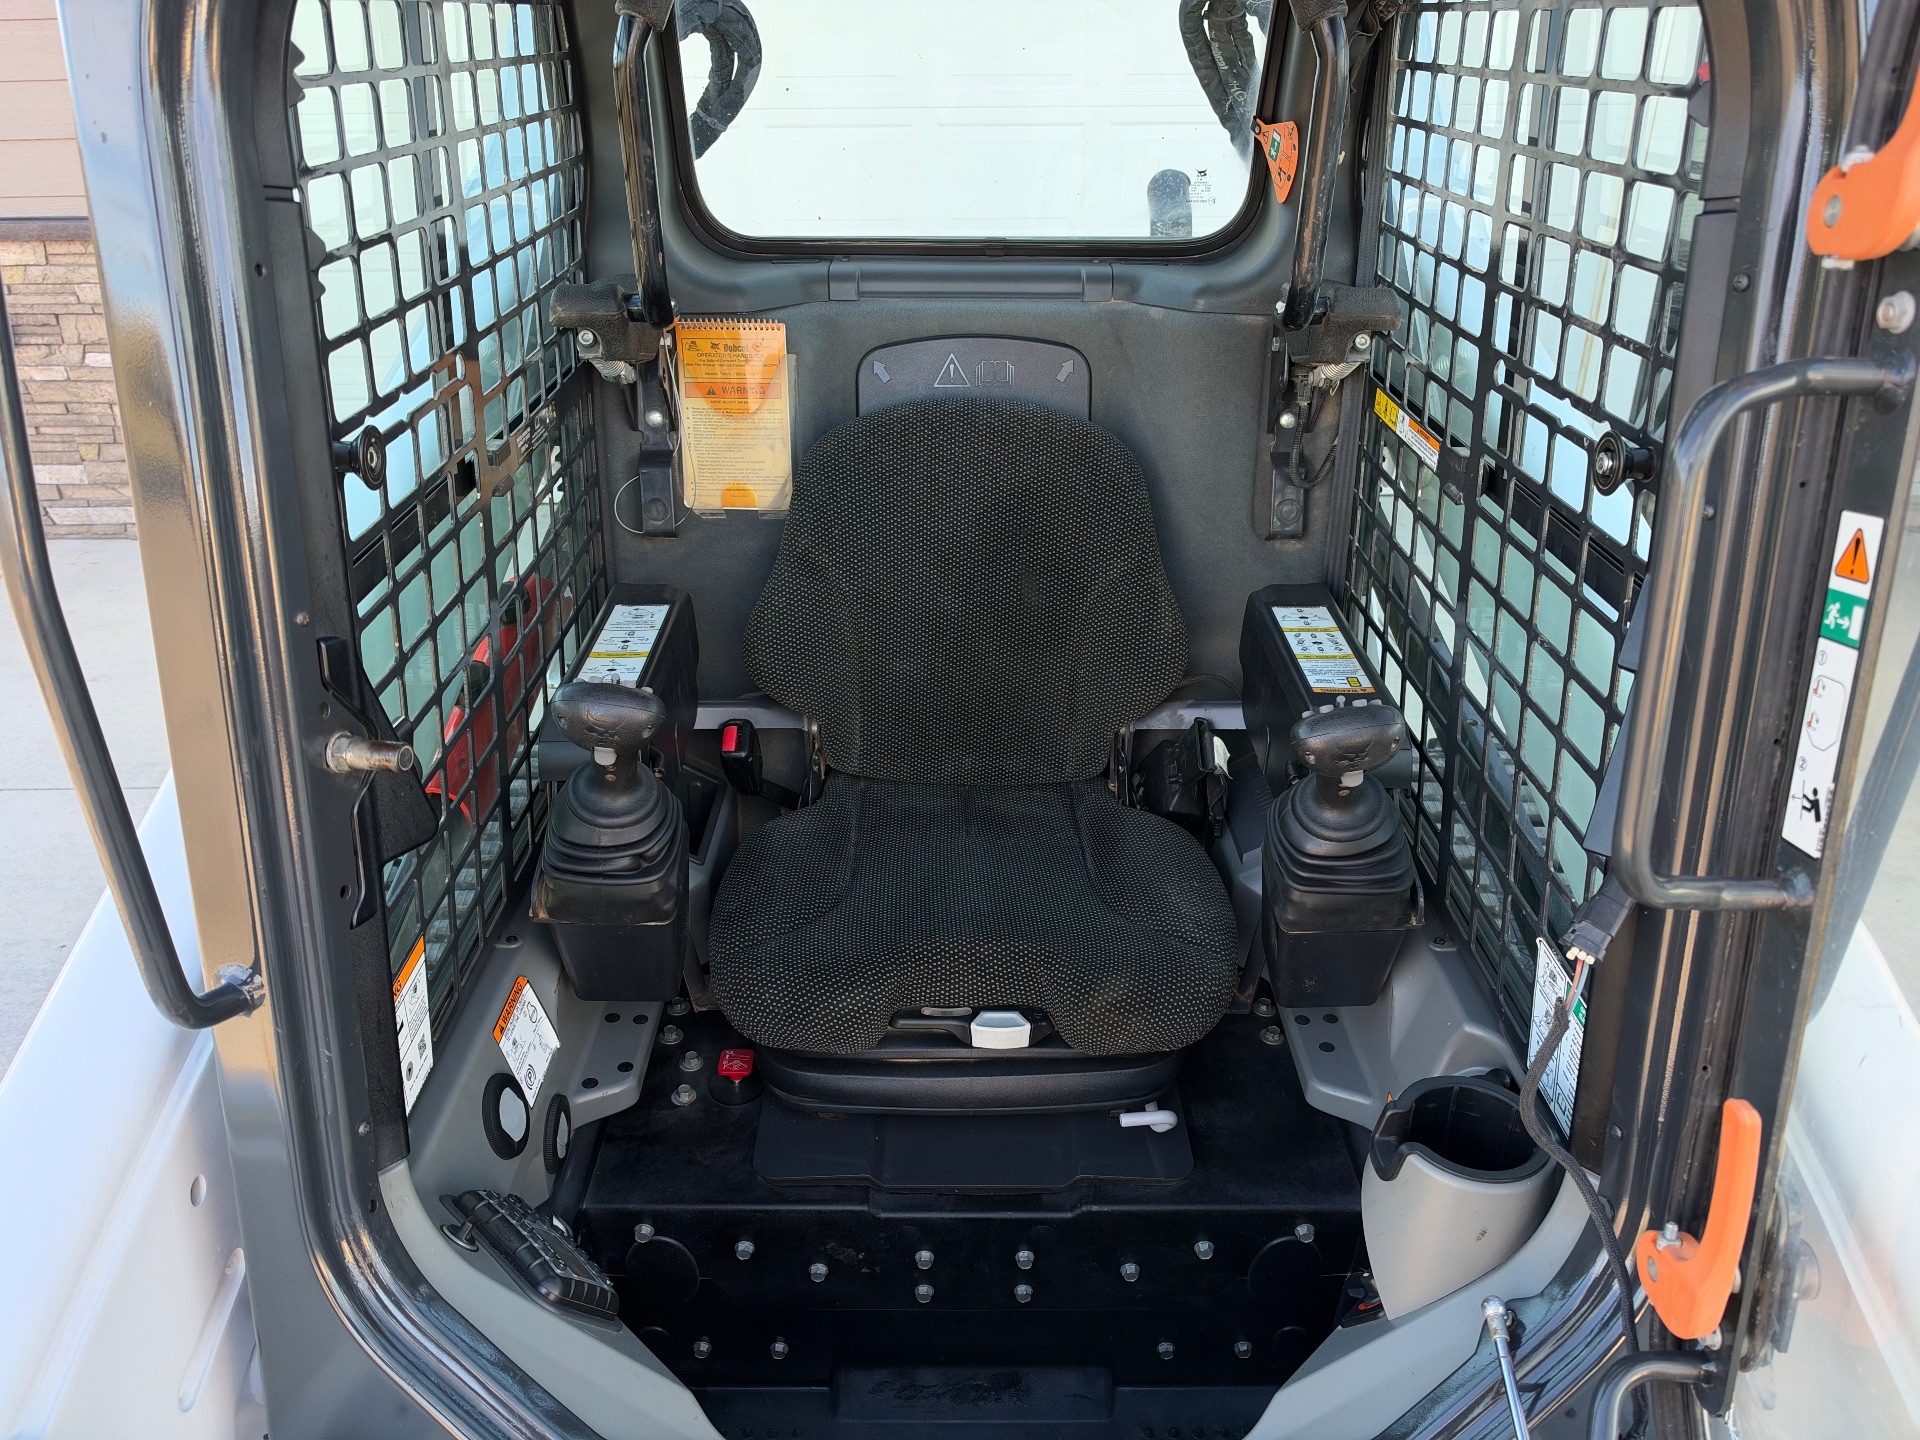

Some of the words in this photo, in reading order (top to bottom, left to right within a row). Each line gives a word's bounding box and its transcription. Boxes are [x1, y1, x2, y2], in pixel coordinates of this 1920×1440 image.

[1210, 42, 1229, 71] Bobcat
[723, 344, 750, 352] Bobcat
[722, 386, 766, 394] WARNING
[502, 981, 523, 1025] WARNING
